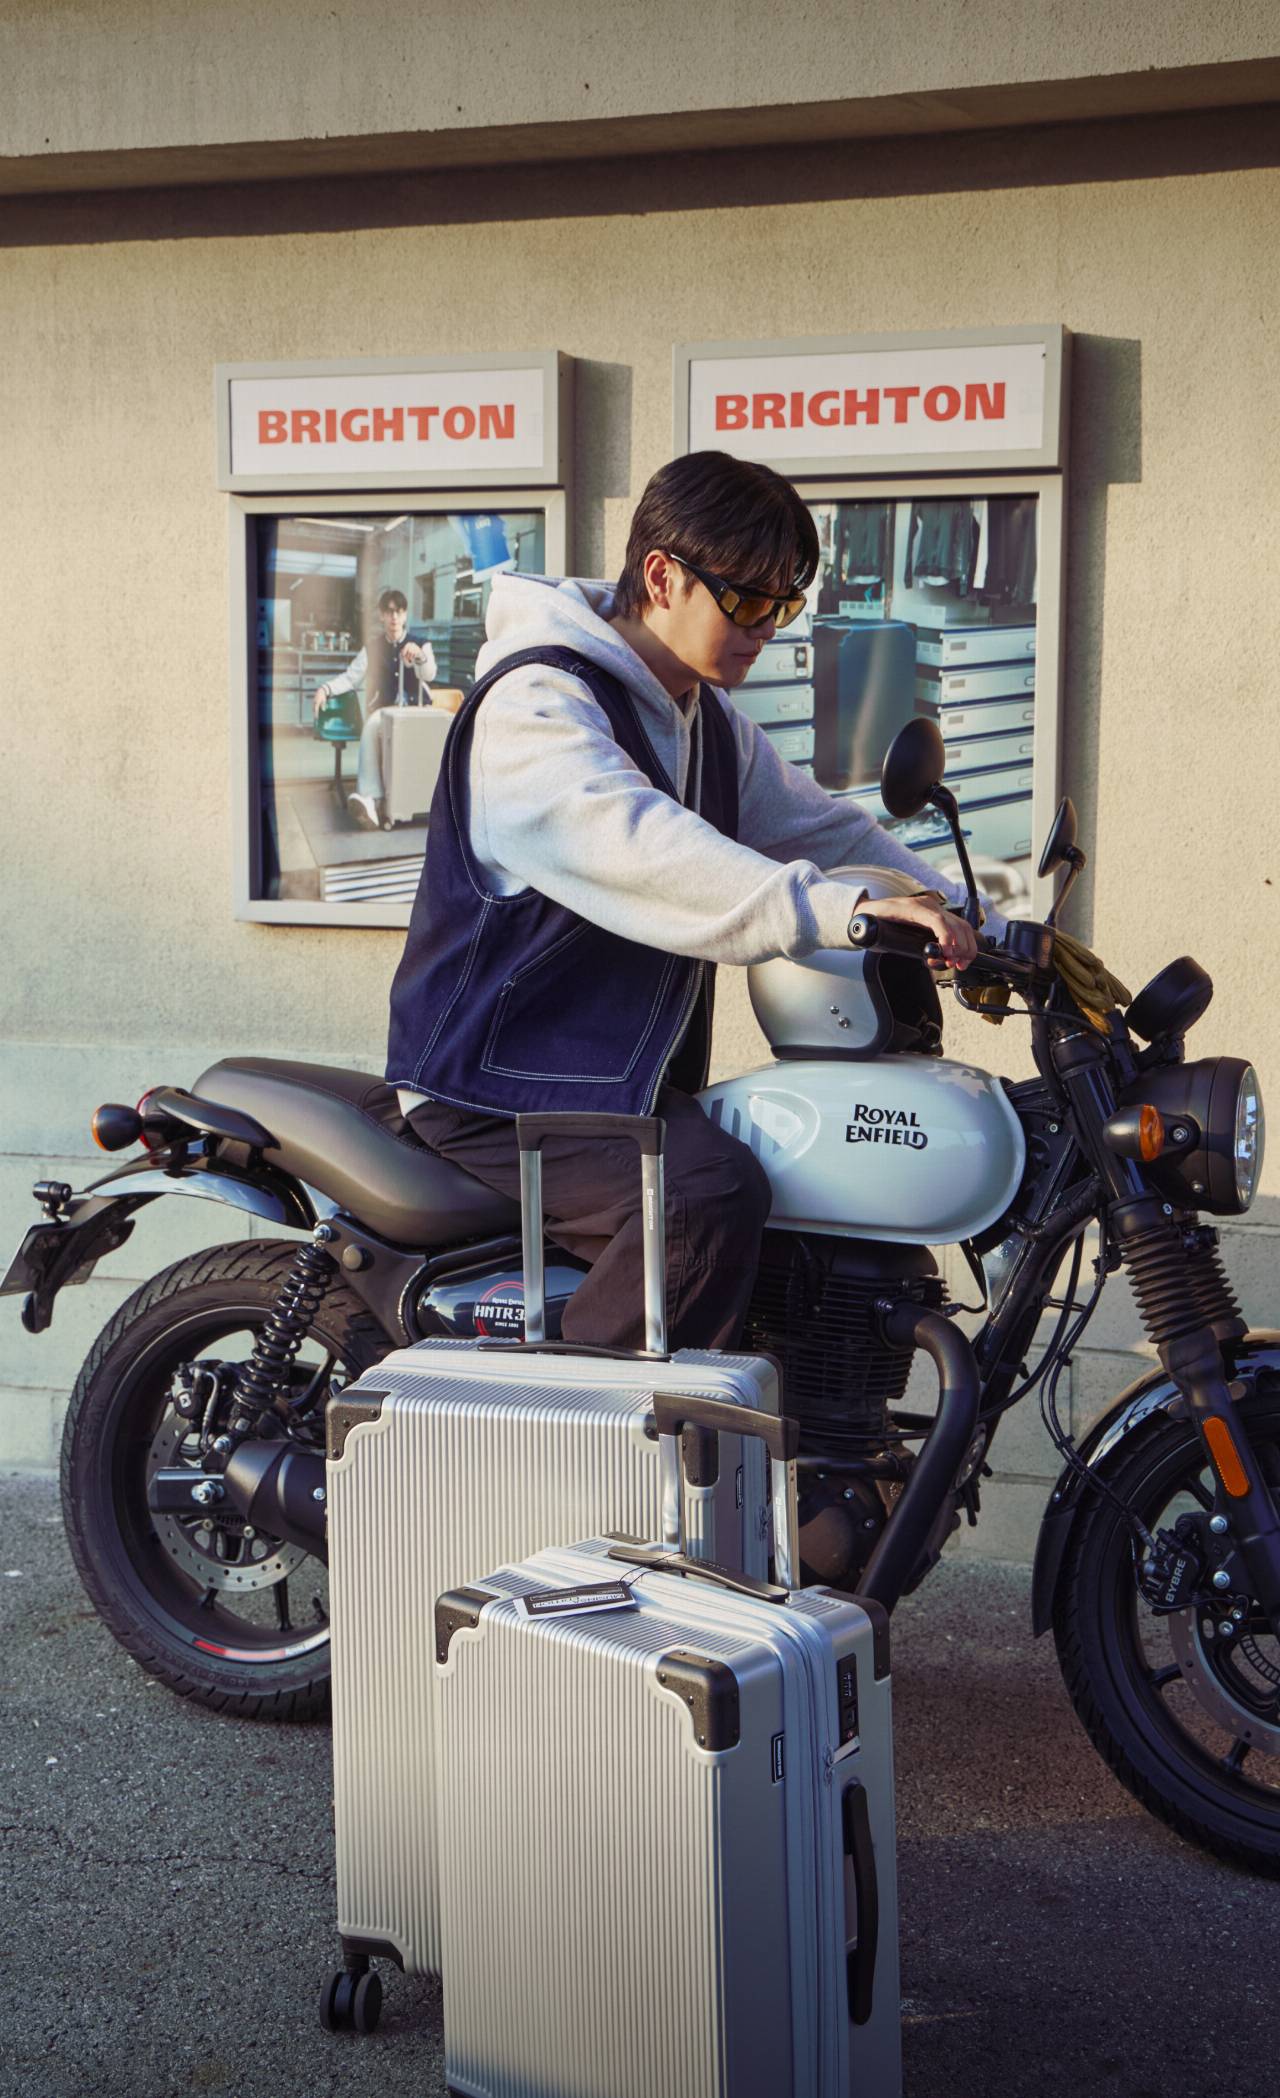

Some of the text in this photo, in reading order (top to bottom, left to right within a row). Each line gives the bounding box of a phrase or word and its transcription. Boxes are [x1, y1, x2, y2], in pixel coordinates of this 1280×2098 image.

[258, 404, 515, 444] BRIGHTON
[714, 382, 1006, 431] BRIGHTON
[853, 1103, 921, 1127] ROYAL
[845, 1124, 929, 1150] ENFIELD
[1165, 1559, 1187, 1603] BYBRE
